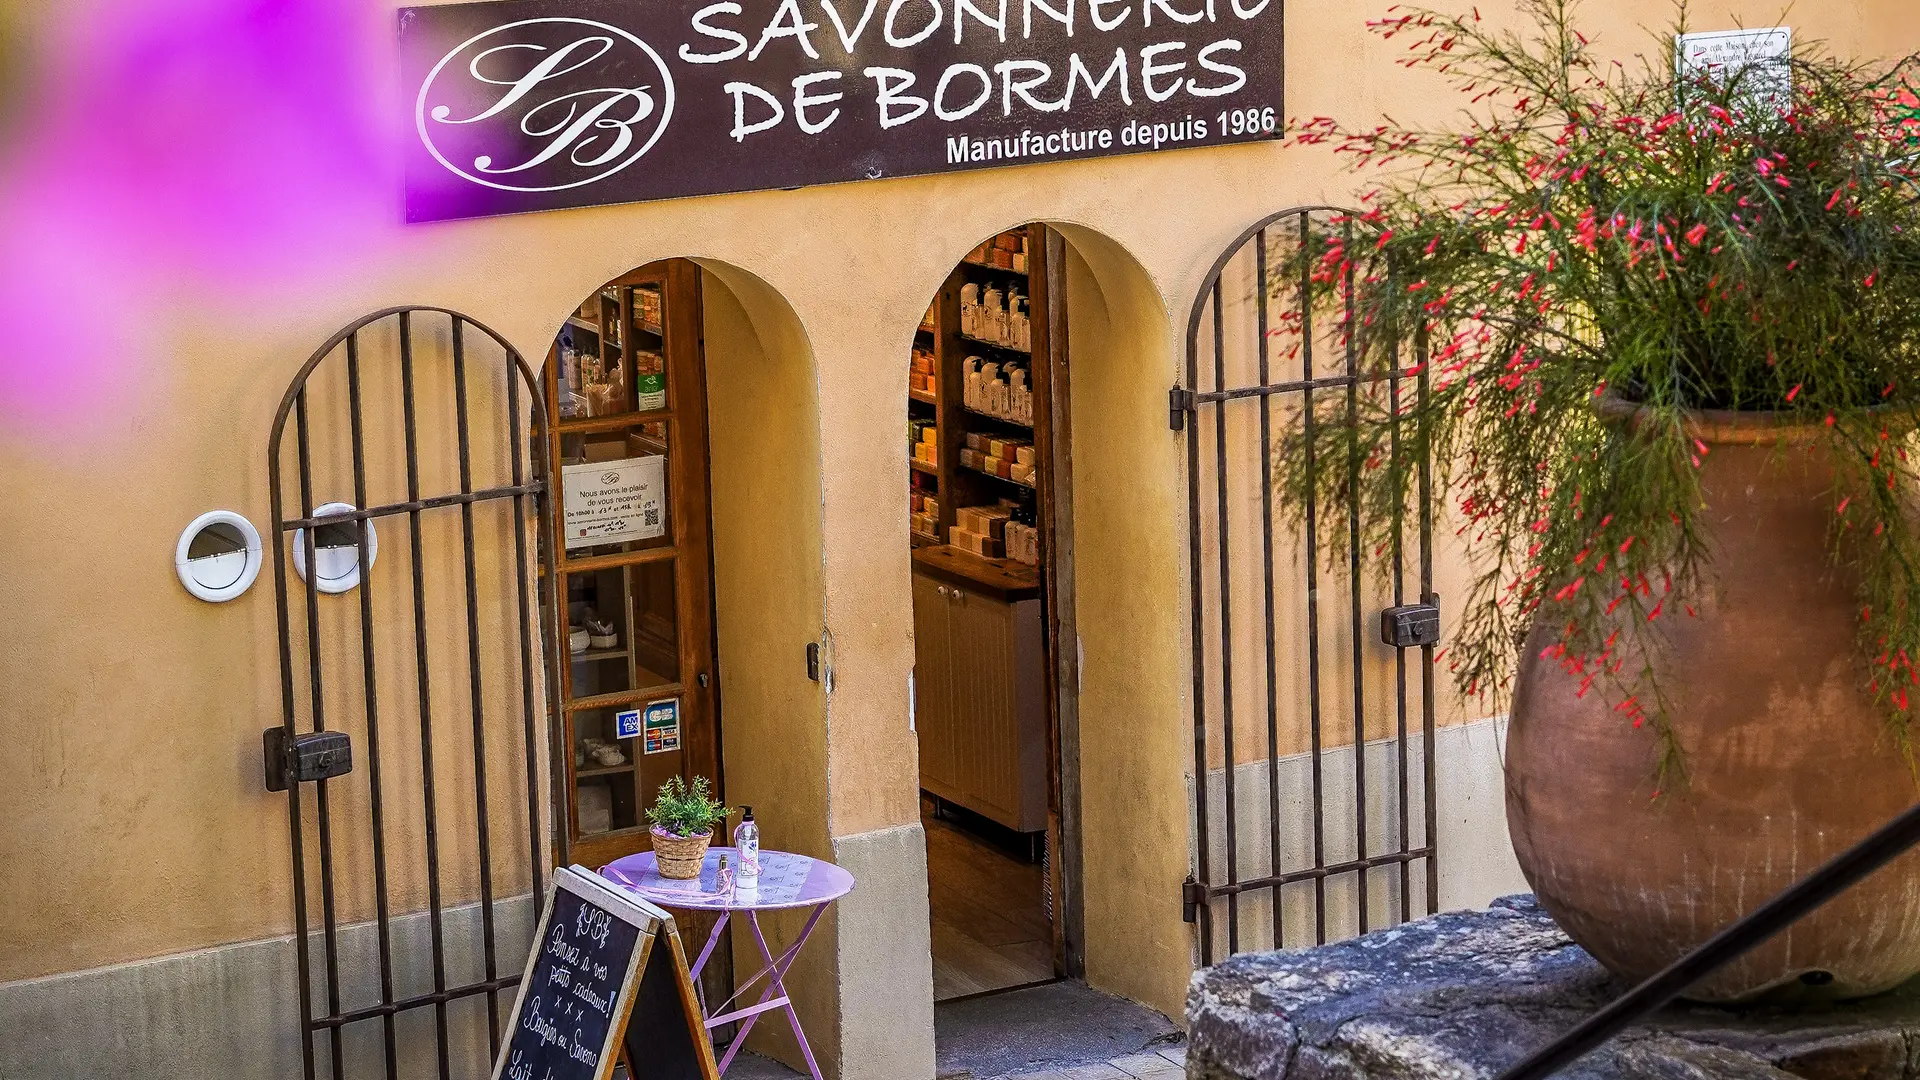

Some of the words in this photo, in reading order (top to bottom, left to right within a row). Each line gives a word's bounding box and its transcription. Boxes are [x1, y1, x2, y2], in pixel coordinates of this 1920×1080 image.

[723, 71, 844, 143] DE
[863, 38, 1248, 130] BORMES
[946, 128, 1114, 164] Manufacture
[1121, 114, 1209, 150] depuis
[1216, 106, 1276, 137] 1986
[579, 490, 598, 498] Nous
[599, 488, 620, 496] avons
[628, 483, 648, 493] plaisir
[597, 497, 614, 505] vous
[615, 494, 642, 503] recevoir
[546, 923, 580, 966] Pensez
[593, 962, 608, 981] vos
[547, 964, 572, 988] petits
[523, 995, 557, 1047] Bougies
[558, 1034, 568, 1050] ou
[569, 1028, 598, 1067] Savons
